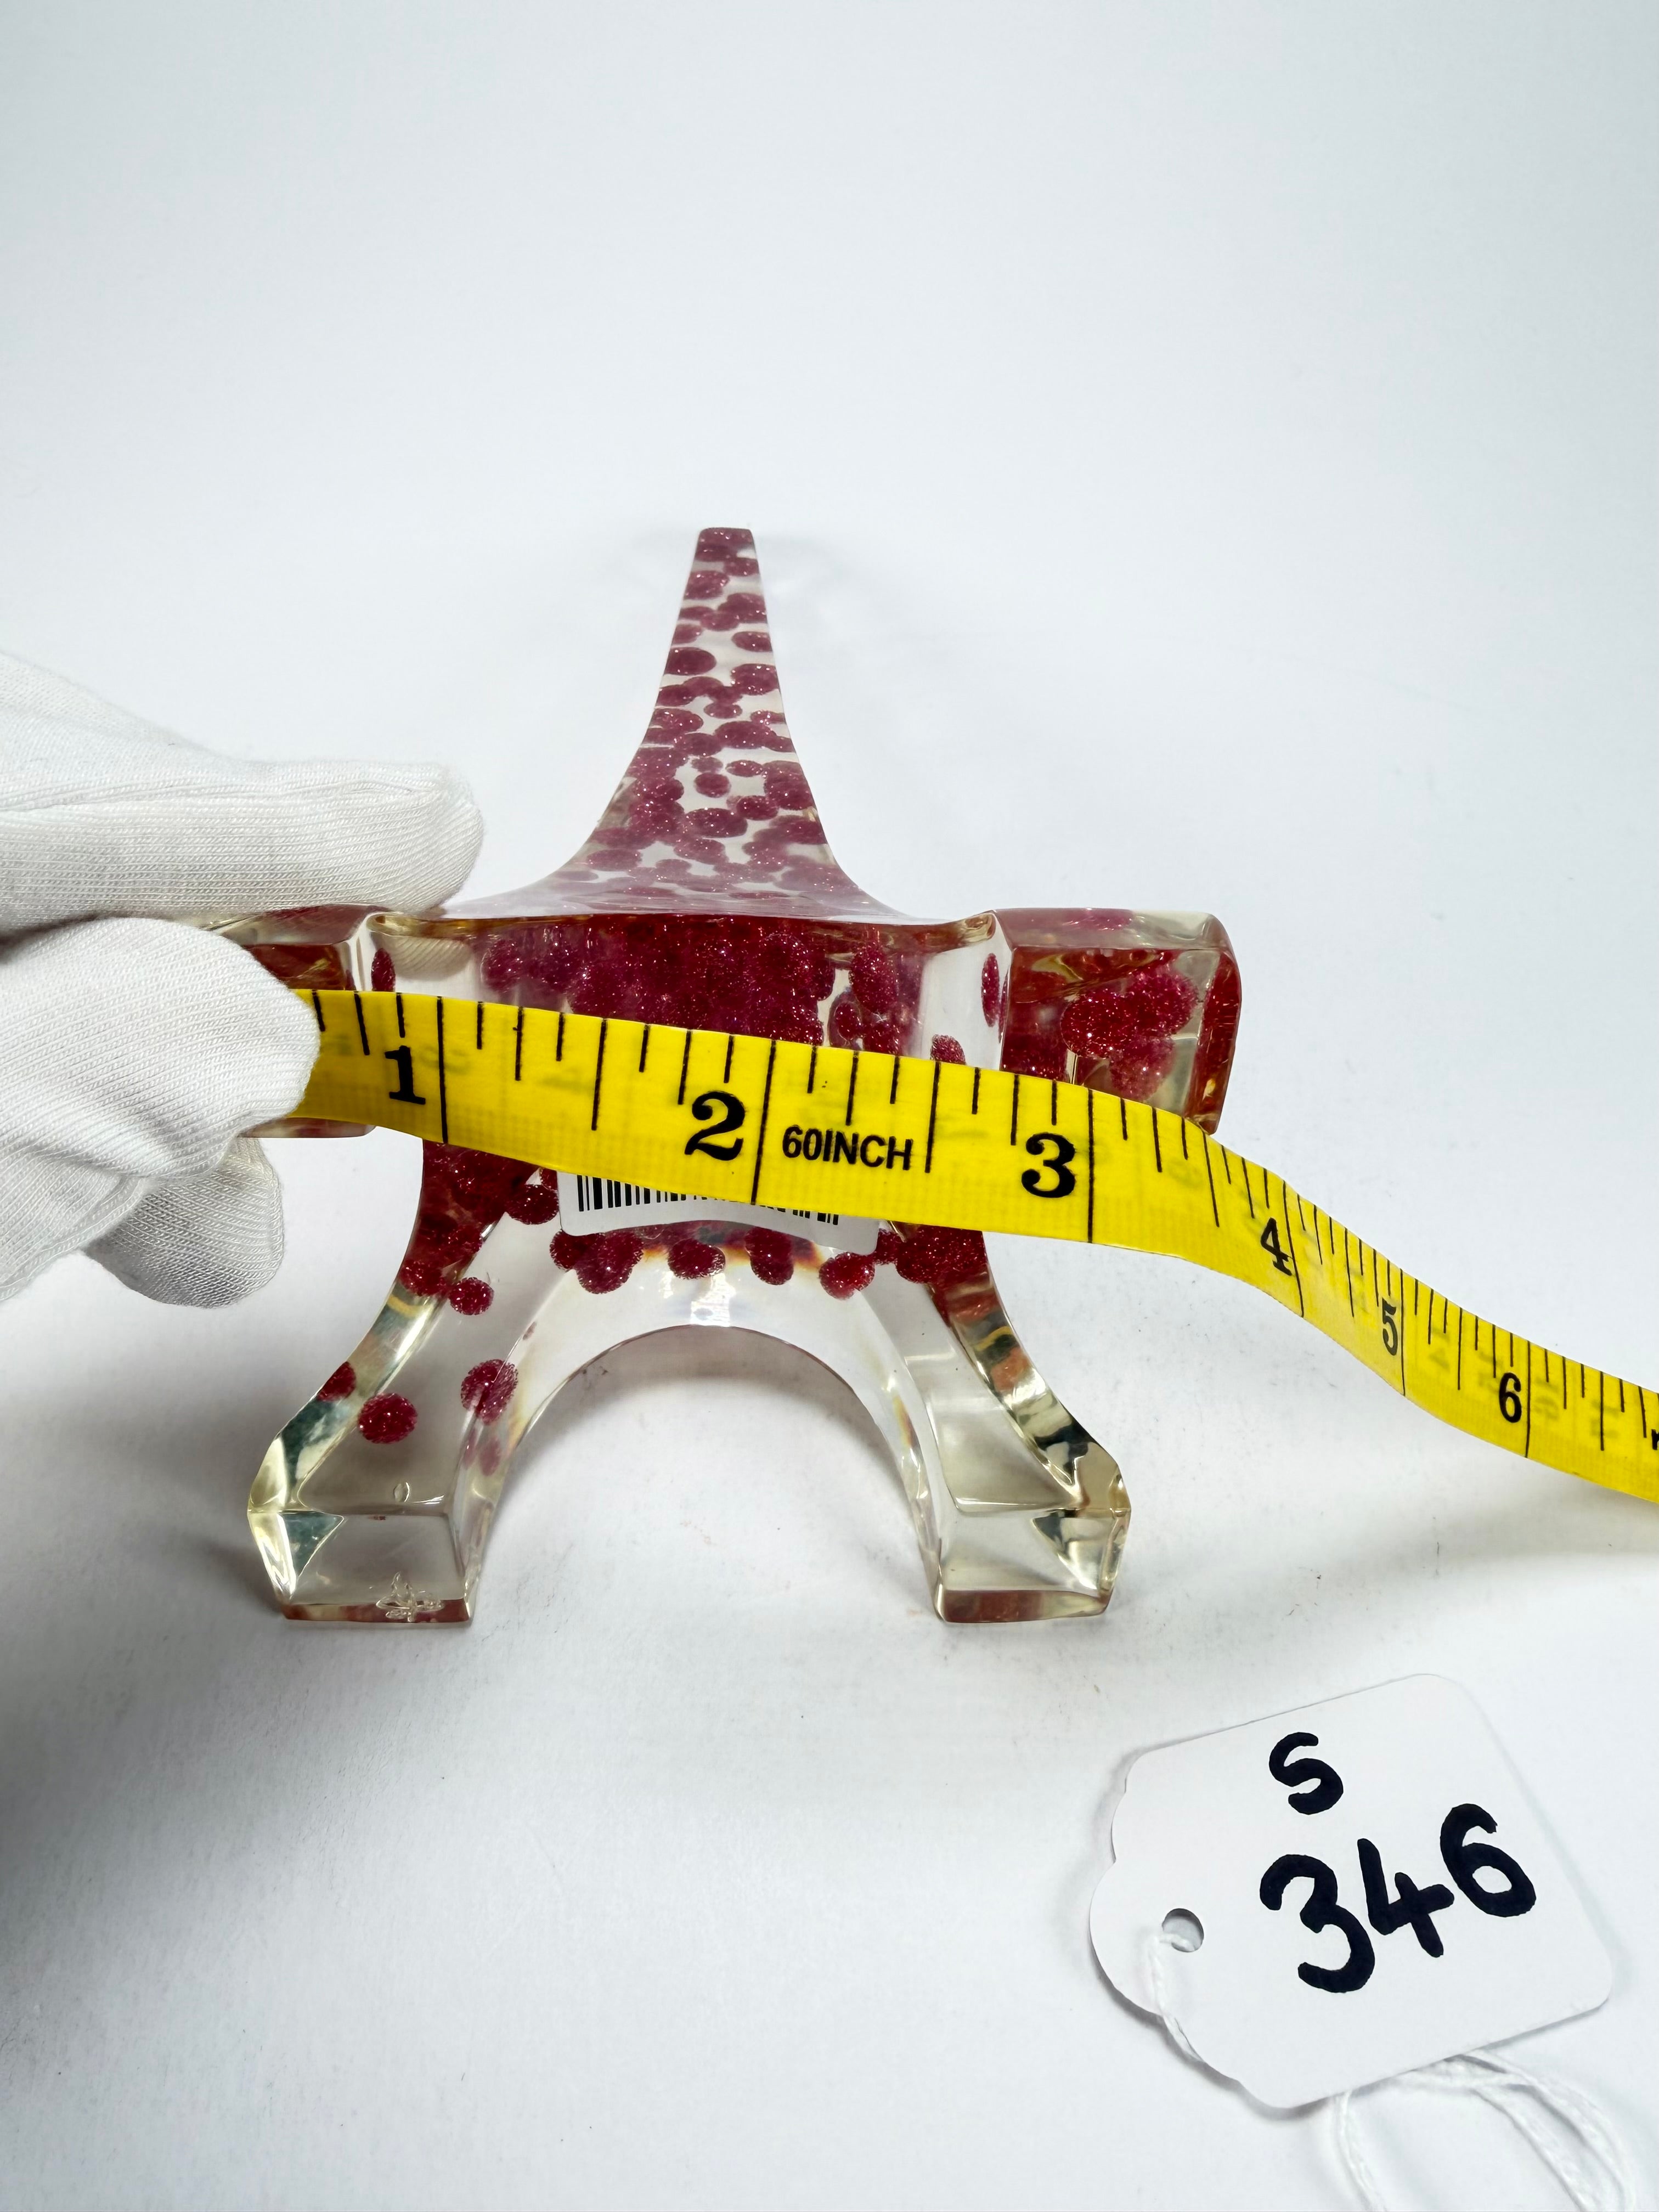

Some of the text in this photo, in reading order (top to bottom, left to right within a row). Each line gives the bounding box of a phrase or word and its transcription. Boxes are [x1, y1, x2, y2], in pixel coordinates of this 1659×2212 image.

[384, 1045, 426, 1105] 1
[685, 1091, 746, 1161] 2
[783, 1125, 913, 1171] 60INCH
[1022, 1132, 1076, 1199] 3
[1261, 1217, 1293, 1276] 4
[1381, 1297, 1398, 1356] 5
[1499, 1373, 1522, 1423] 6
[1260, 1803, 1536, 1993] 346
